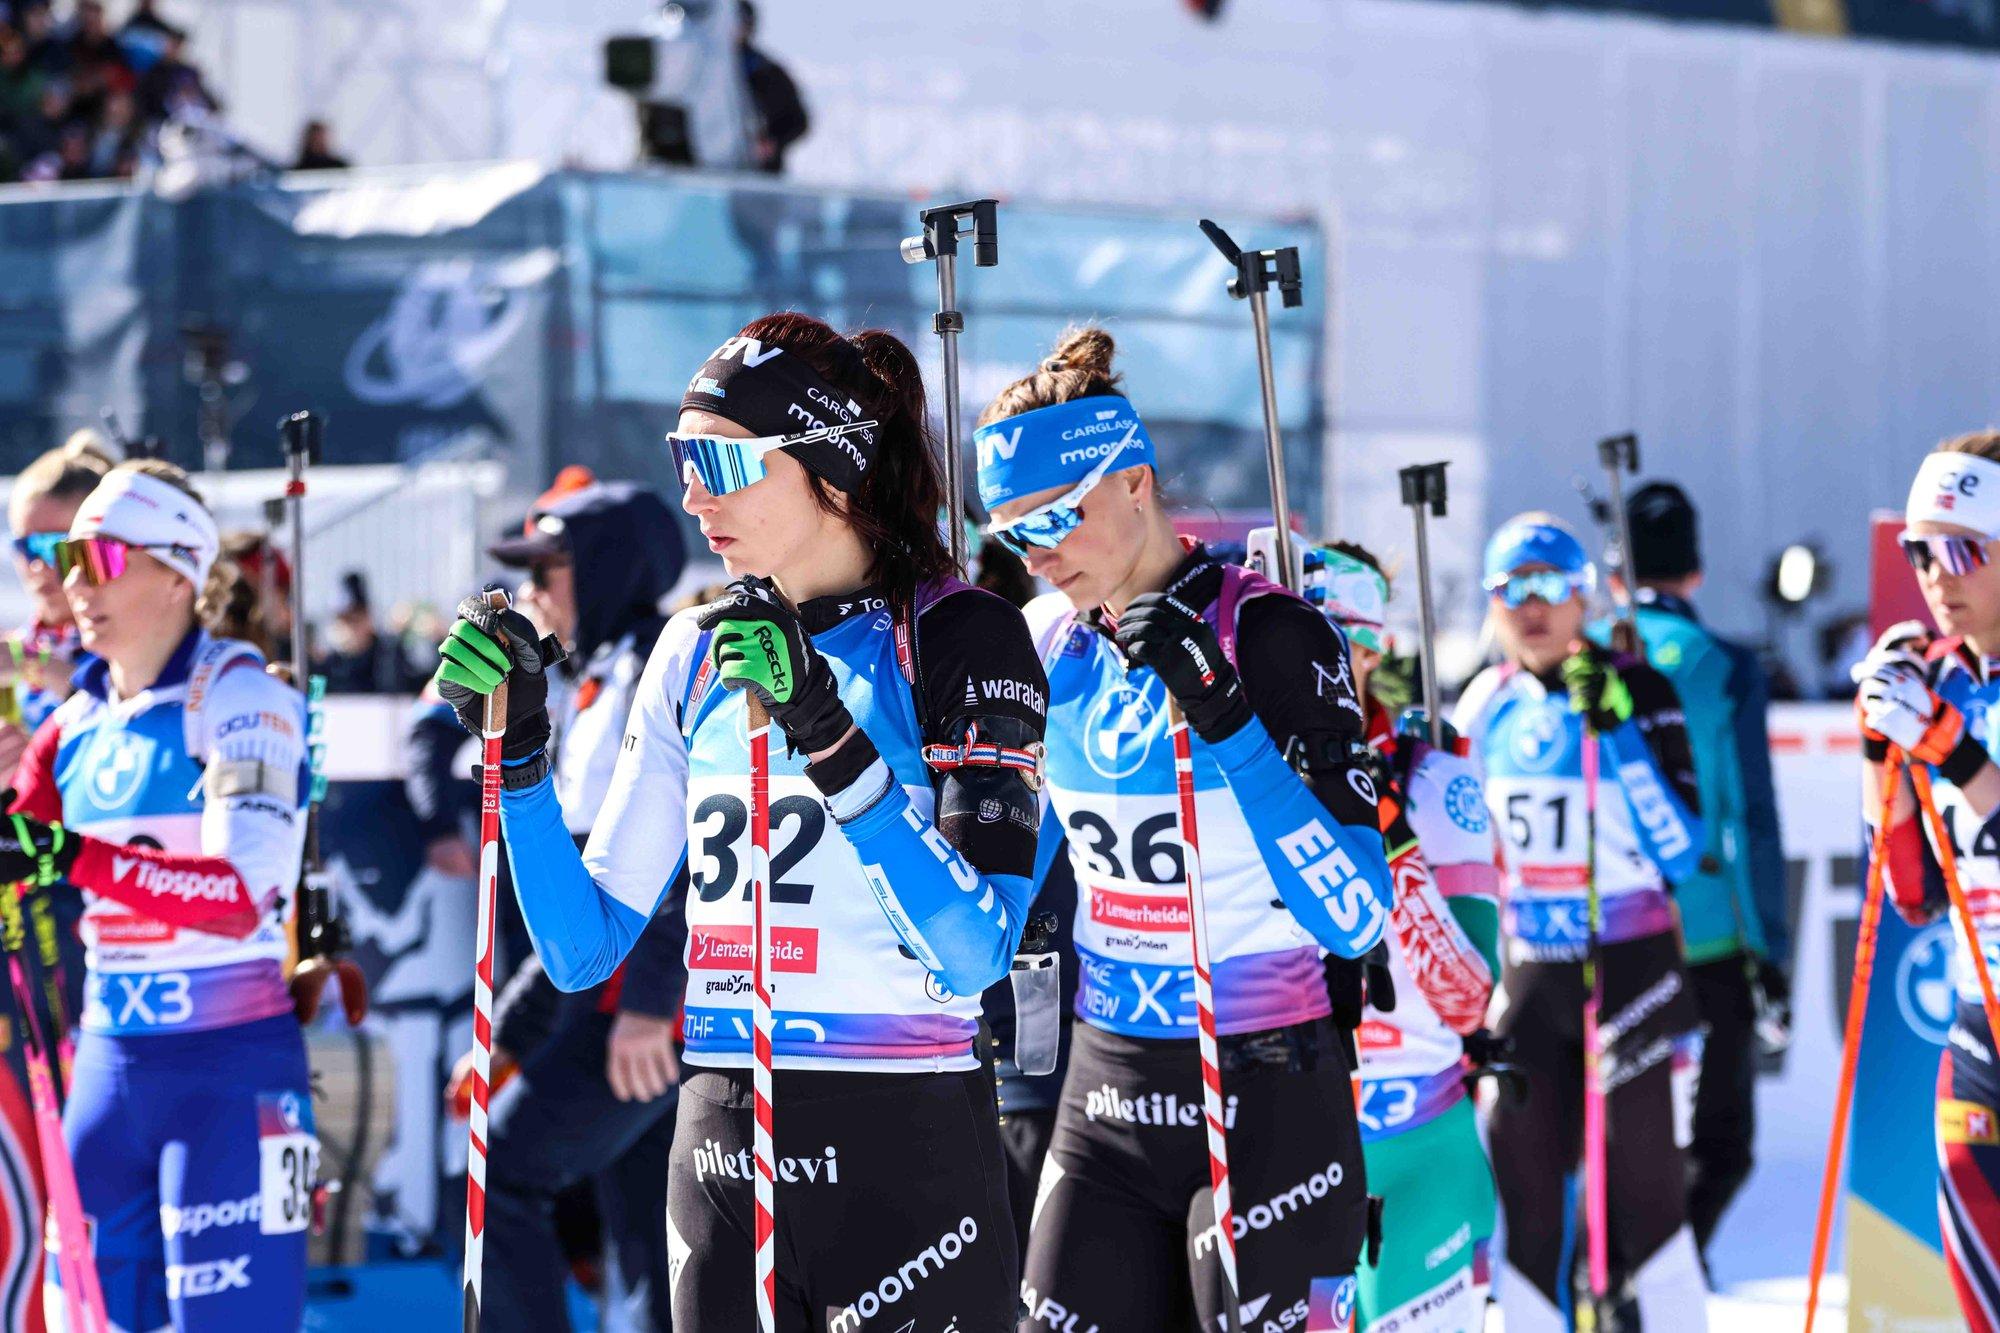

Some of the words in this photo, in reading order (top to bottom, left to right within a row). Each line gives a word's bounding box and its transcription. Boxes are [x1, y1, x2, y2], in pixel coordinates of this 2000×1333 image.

[807, 387, 874, 445] CARGSS
[982, 679, 1045, 717] waratah
[1069, 810, 1187, 884] 36
[1508, 794, 1568, 849] 51
[692, 794, 826, 904] 32
[134, 860, 240, 903] Tipsport
[711, 940, 804, 960] Lenzereide
[119, 972, 193, 1025] X3
[1082, 984, 1120, 1019] NEW
[1086, 1084, 1239, 1130] piletilei
[830, 1216, 978, 1333] moomoo
